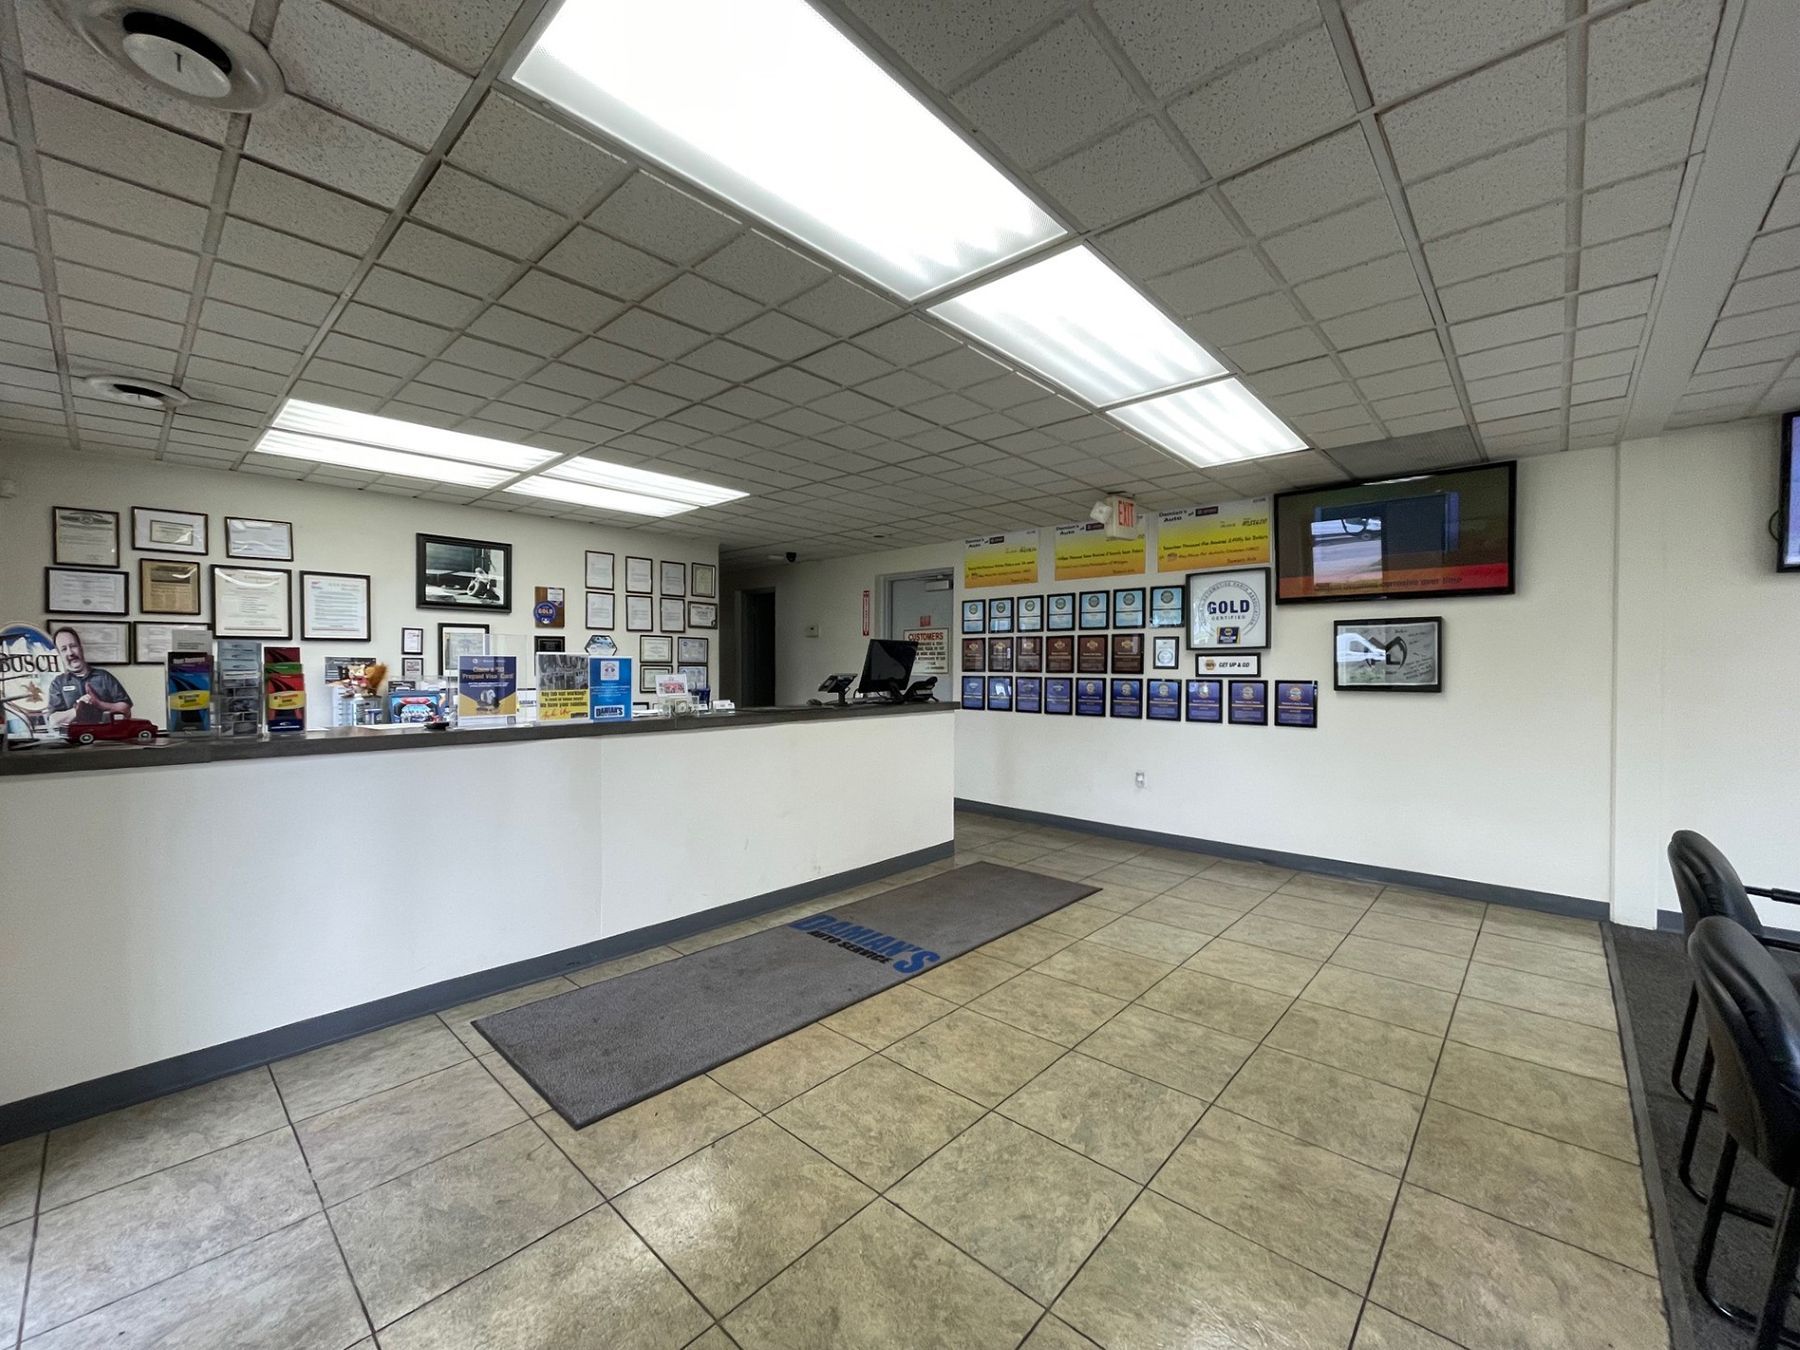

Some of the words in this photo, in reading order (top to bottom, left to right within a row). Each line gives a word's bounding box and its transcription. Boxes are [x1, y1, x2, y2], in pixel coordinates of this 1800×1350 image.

[1117, 500, 1134, 528] EXIT
[1207, 600, 1250, 614] GOLD
[907, 632, 944, 641] CUSTOMERS
[0, 654, 61, 672] BUSCH
[596, 707, 623, 717] DAMIAN'S
[788, 914, 941, 974] DAMIAN'S
[807, 930, 842, 944] AUTO
[837, 941, 893, 965] SERVICE
